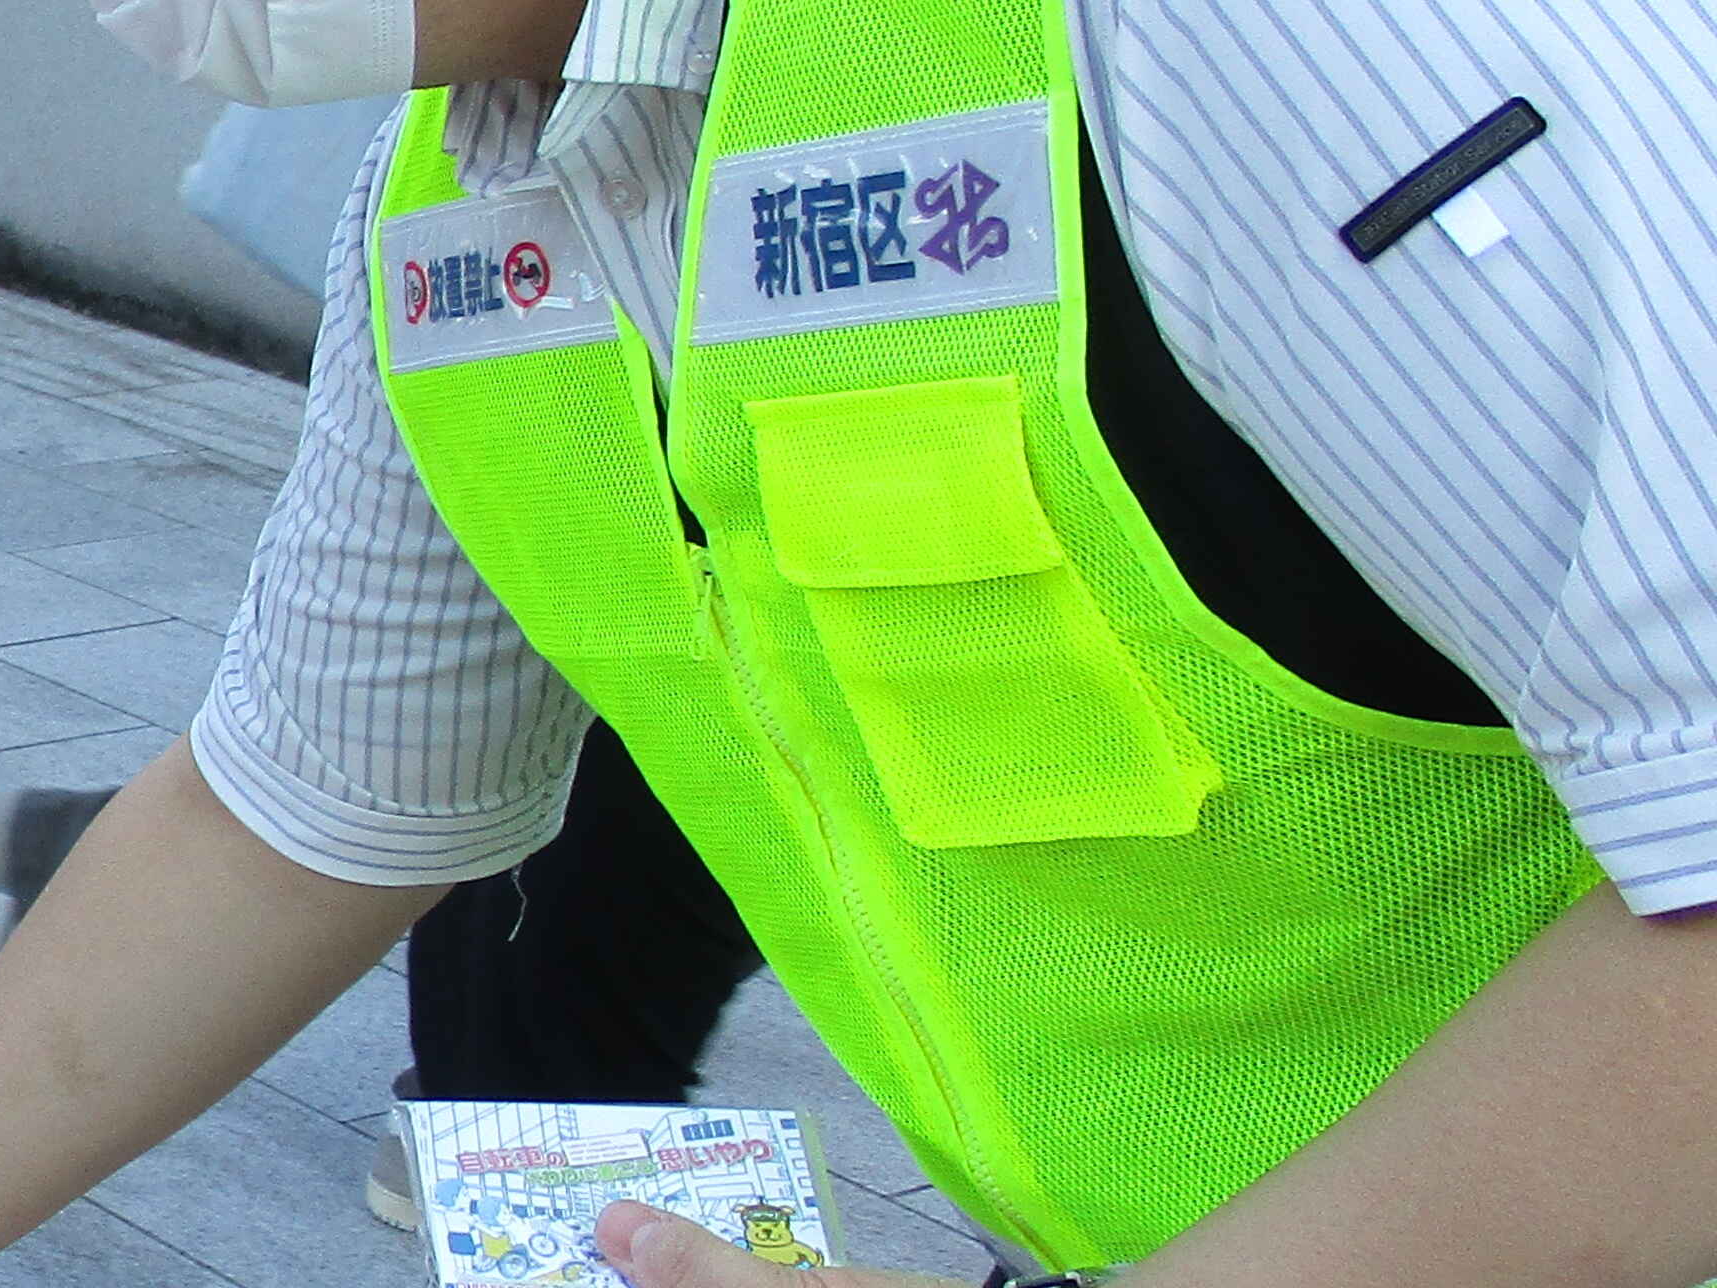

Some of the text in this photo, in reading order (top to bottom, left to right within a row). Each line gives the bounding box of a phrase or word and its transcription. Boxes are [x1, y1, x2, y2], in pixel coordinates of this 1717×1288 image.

[750, 171, 916, 298] 新宿区
[428, 247, 505, 323] 放置禁止
[456, 1145, 566, 1174] 自転車の
[656, 1138, 773, 1172] 思いやり
